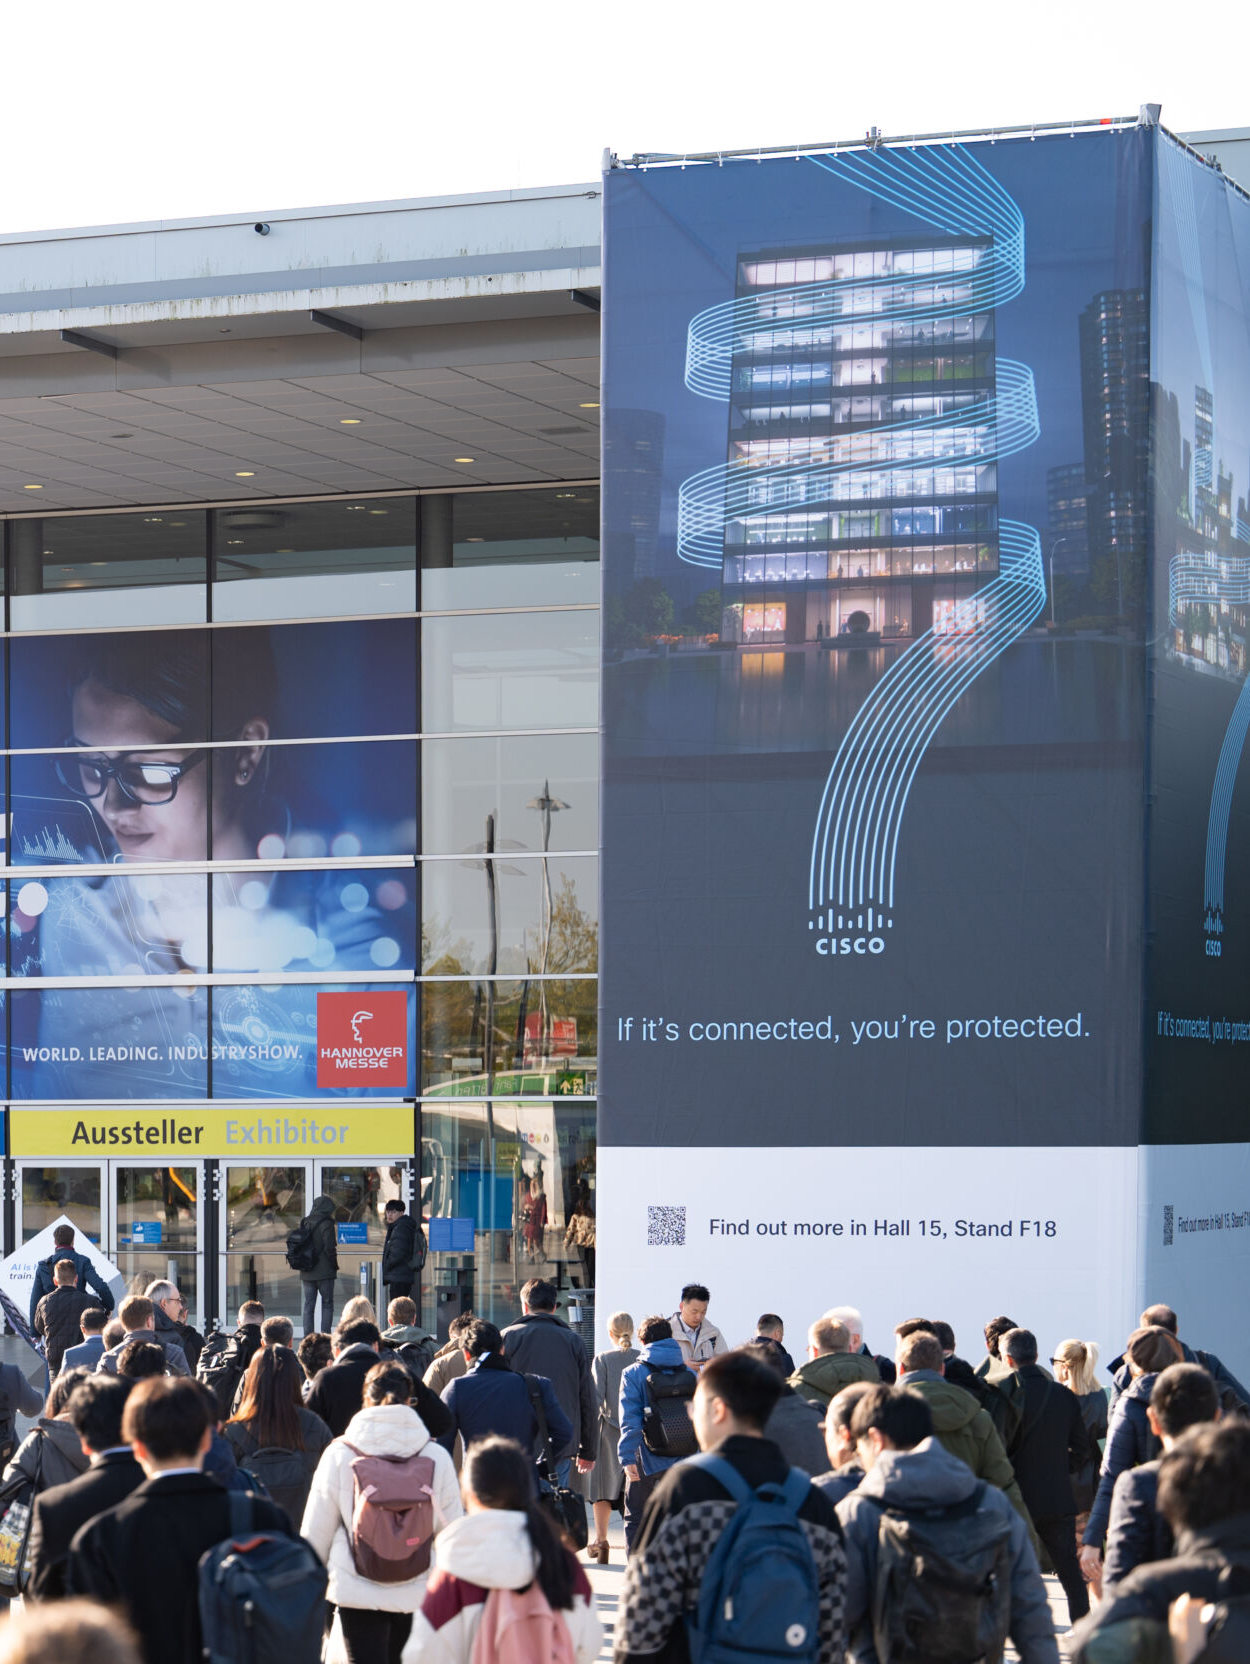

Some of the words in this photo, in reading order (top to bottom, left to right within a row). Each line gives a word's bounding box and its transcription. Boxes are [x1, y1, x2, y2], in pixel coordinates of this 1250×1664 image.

[617, 1017, 633, 1041] If
[642, 1017, 679, 1041] it’s
[689, 1015, 841, 1044] connected,
[850, 1014, 936, 1045] you’re
[947, 1013, 1090, 1044] protected.
[22, 1047, 85, 1062] WORLD.
[89, 1046, 163, 1061] LEADING.
[168, 1045, 303, 1061] INDUSTRYSHOW.
[321, 1047, 403, 1059] HANNOVER
[335, 1058, 389, 1069] MESSE
[71, 1119, 204, 1145] Aussteller
[225, 1119, 350, 1145] Exhibitor
[709, 1218, 749, 1236] Find
[756, 1220, 787, 1236] out
[794, 1222, 844, 1236] more
[850, 1218, 867, 1236] in
[874, 1218, 910, 1236] Hall
[918, 1219, 948, 1240] 15,
[954, 1219, 1013, 1237] Stand
[1020, 1220, 1057, 1237] F18
